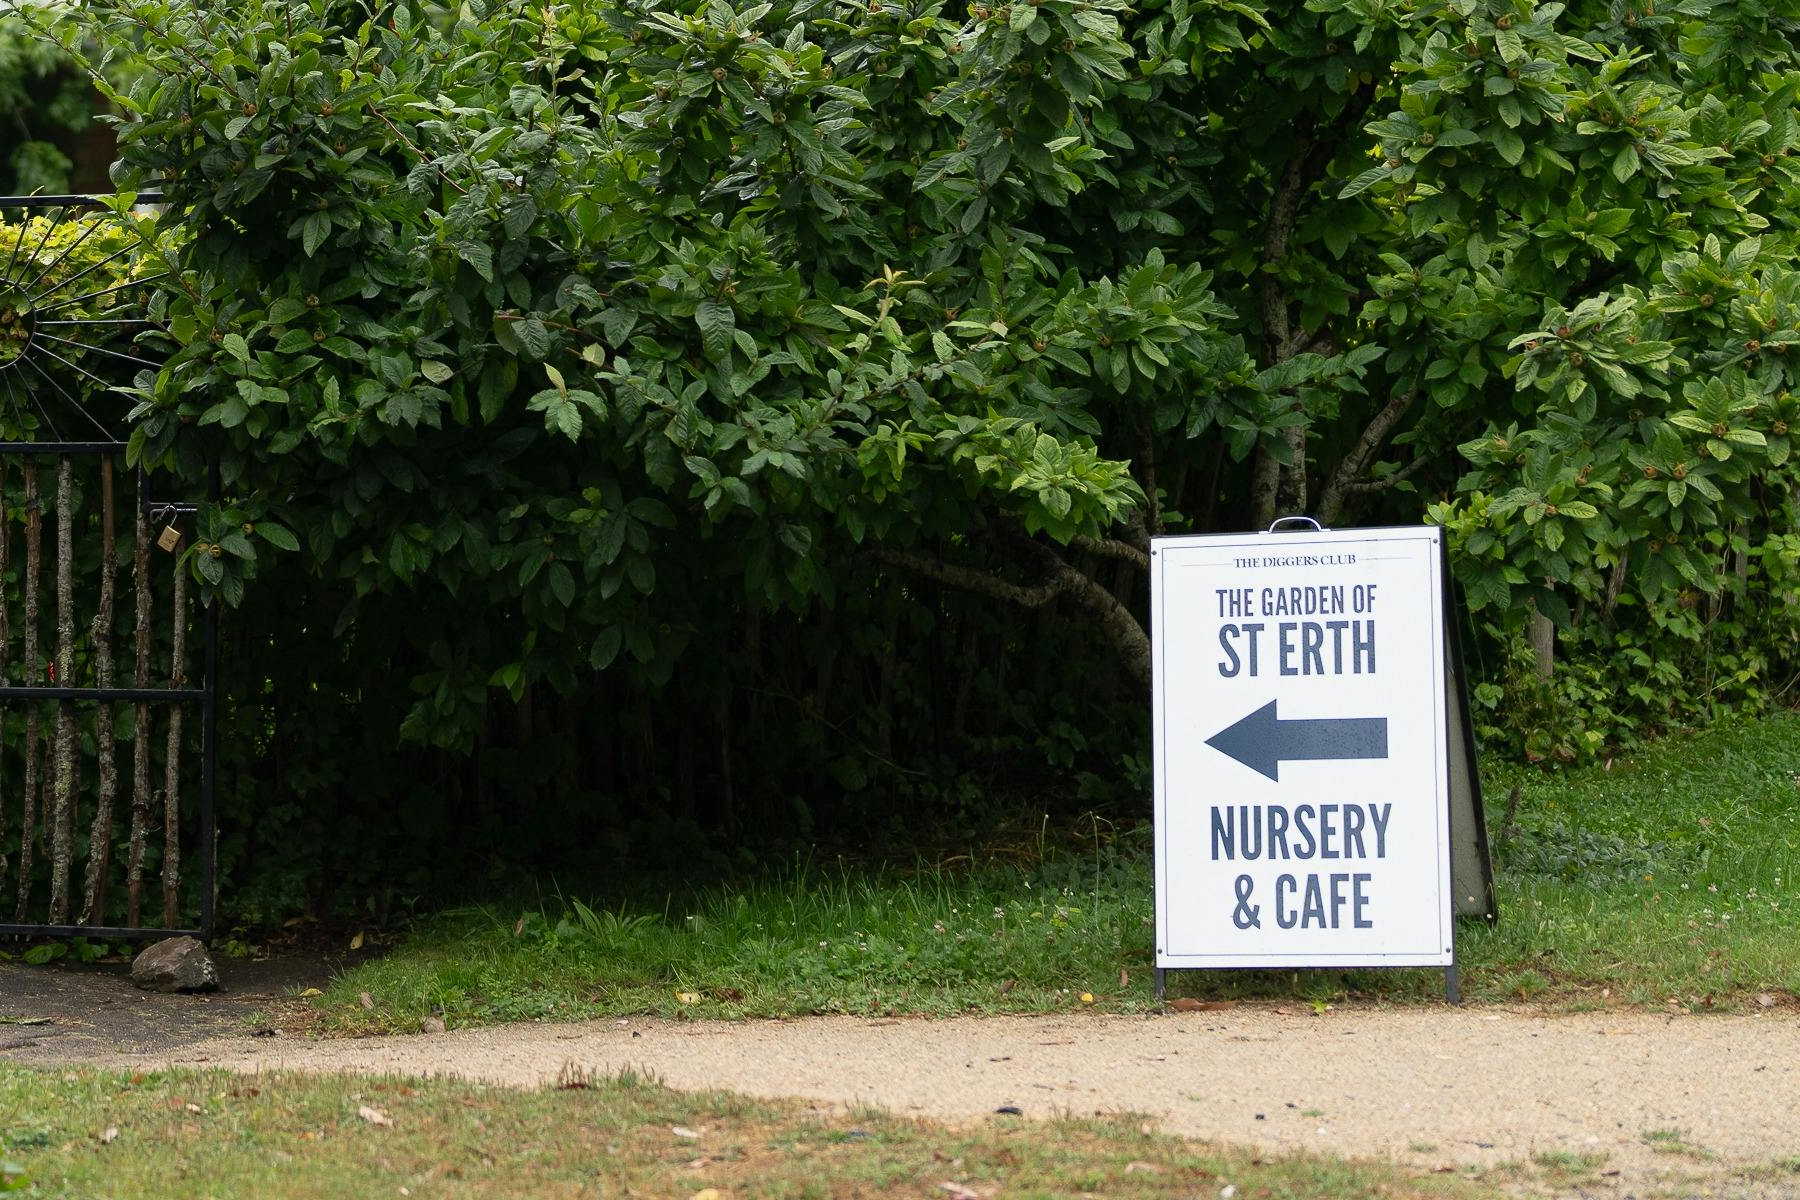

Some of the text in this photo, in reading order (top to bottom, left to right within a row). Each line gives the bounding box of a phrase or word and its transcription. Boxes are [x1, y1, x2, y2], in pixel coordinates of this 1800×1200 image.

[1233, 554, 1357, 569] THE DIGGERS CLUB
[1215, 584, 1377, 618] THE GARDEN OF
[1218, 619, 1376, 678] ST ERTH
[1210, 803, 1392, 861] NURSERY
[1232, 873, 1373, 930] & CAFE
